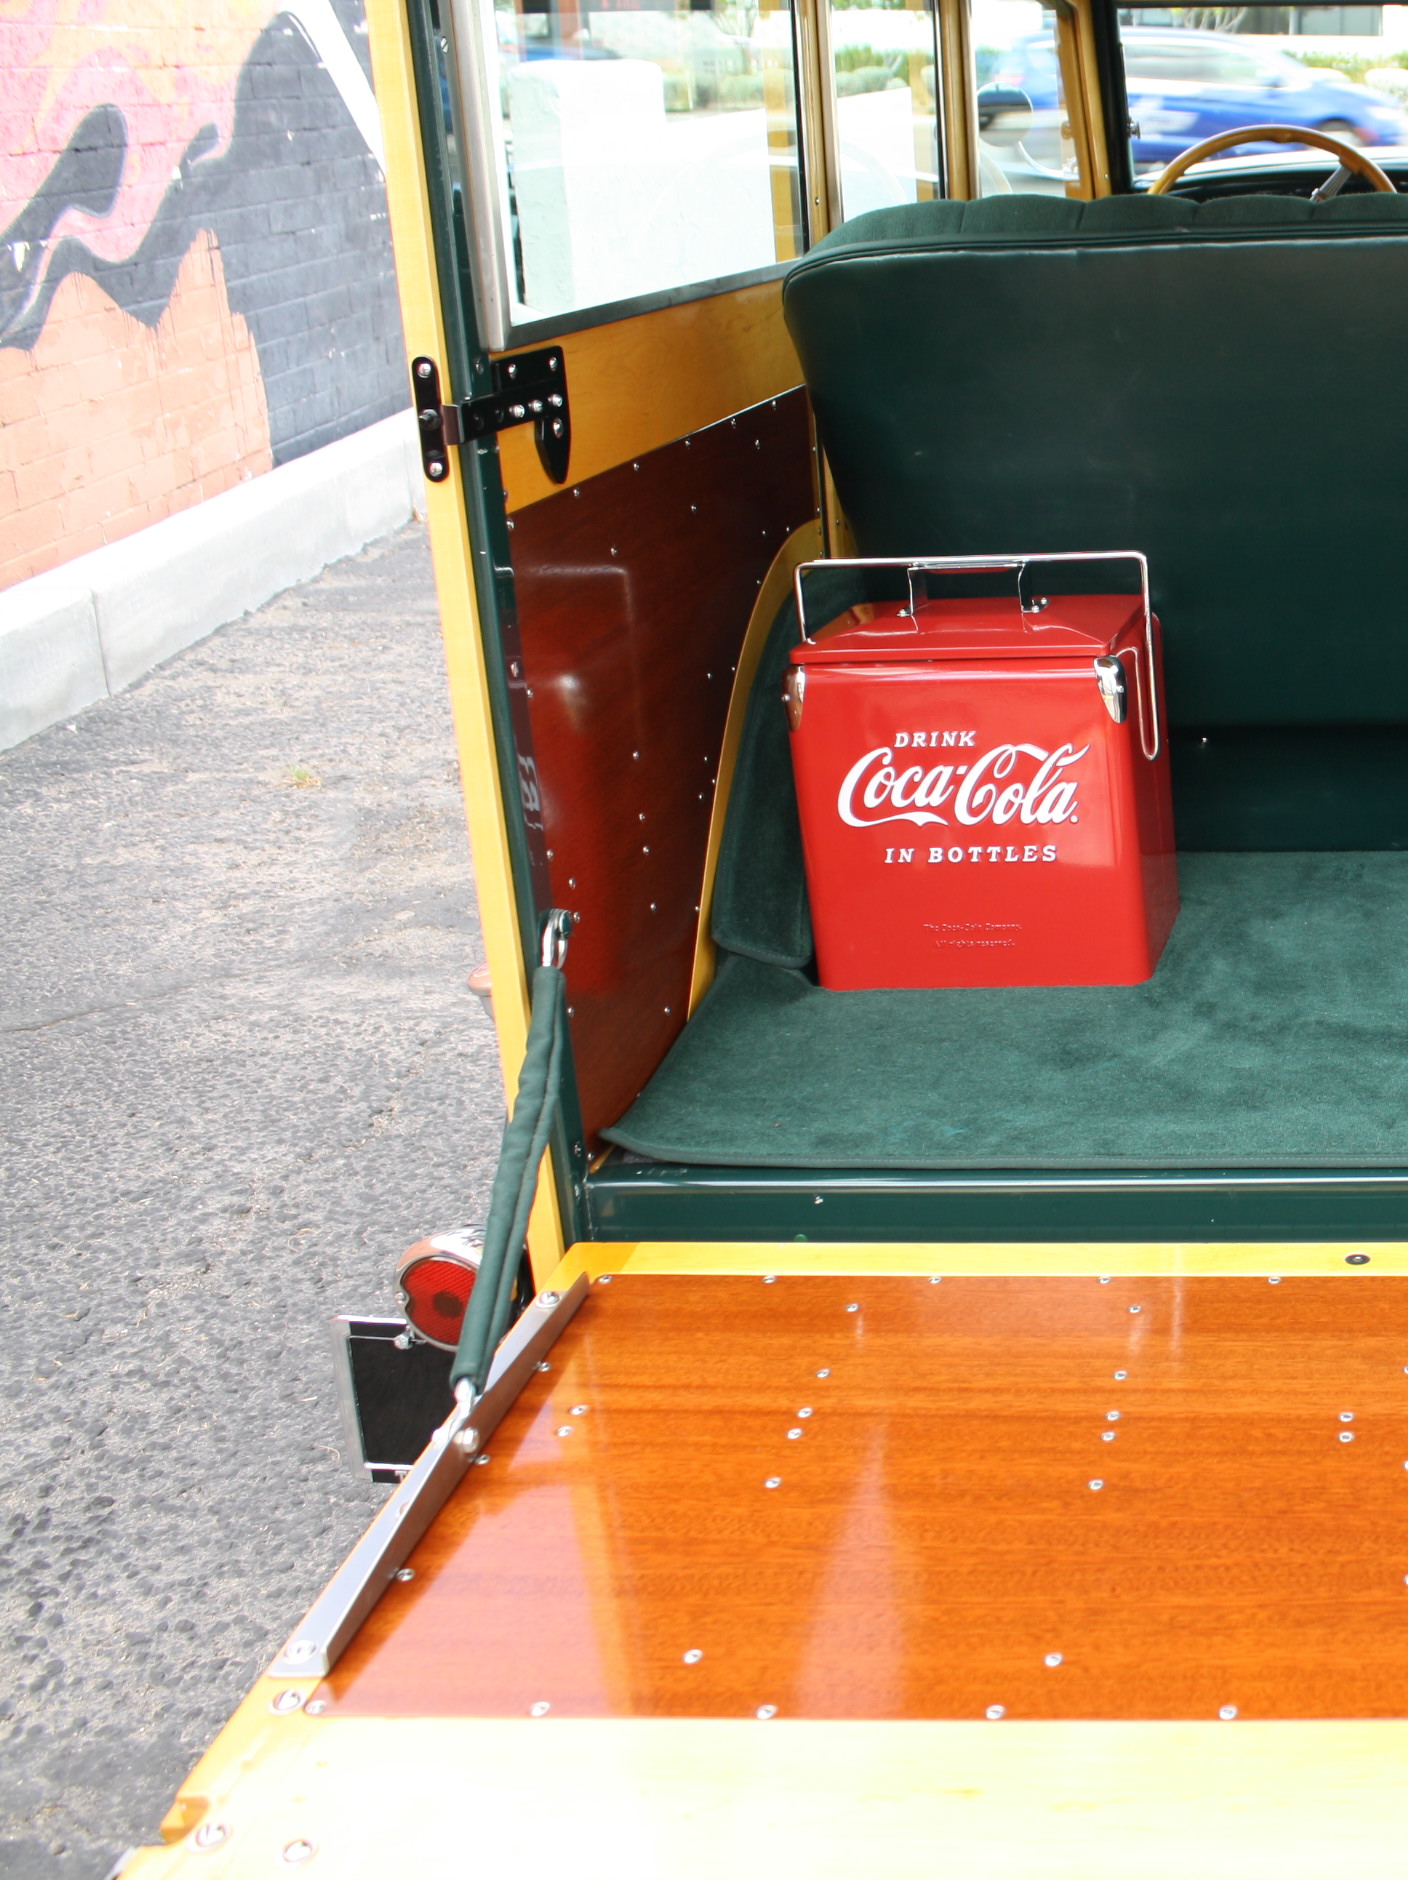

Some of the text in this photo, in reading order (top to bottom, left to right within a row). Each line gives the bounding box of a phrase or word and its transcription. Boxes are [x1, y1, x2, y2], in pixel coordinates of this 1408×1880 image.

[893, 730, 977, 748] DRINK
[884, 844, 1058, 864] IN BOTTLES
